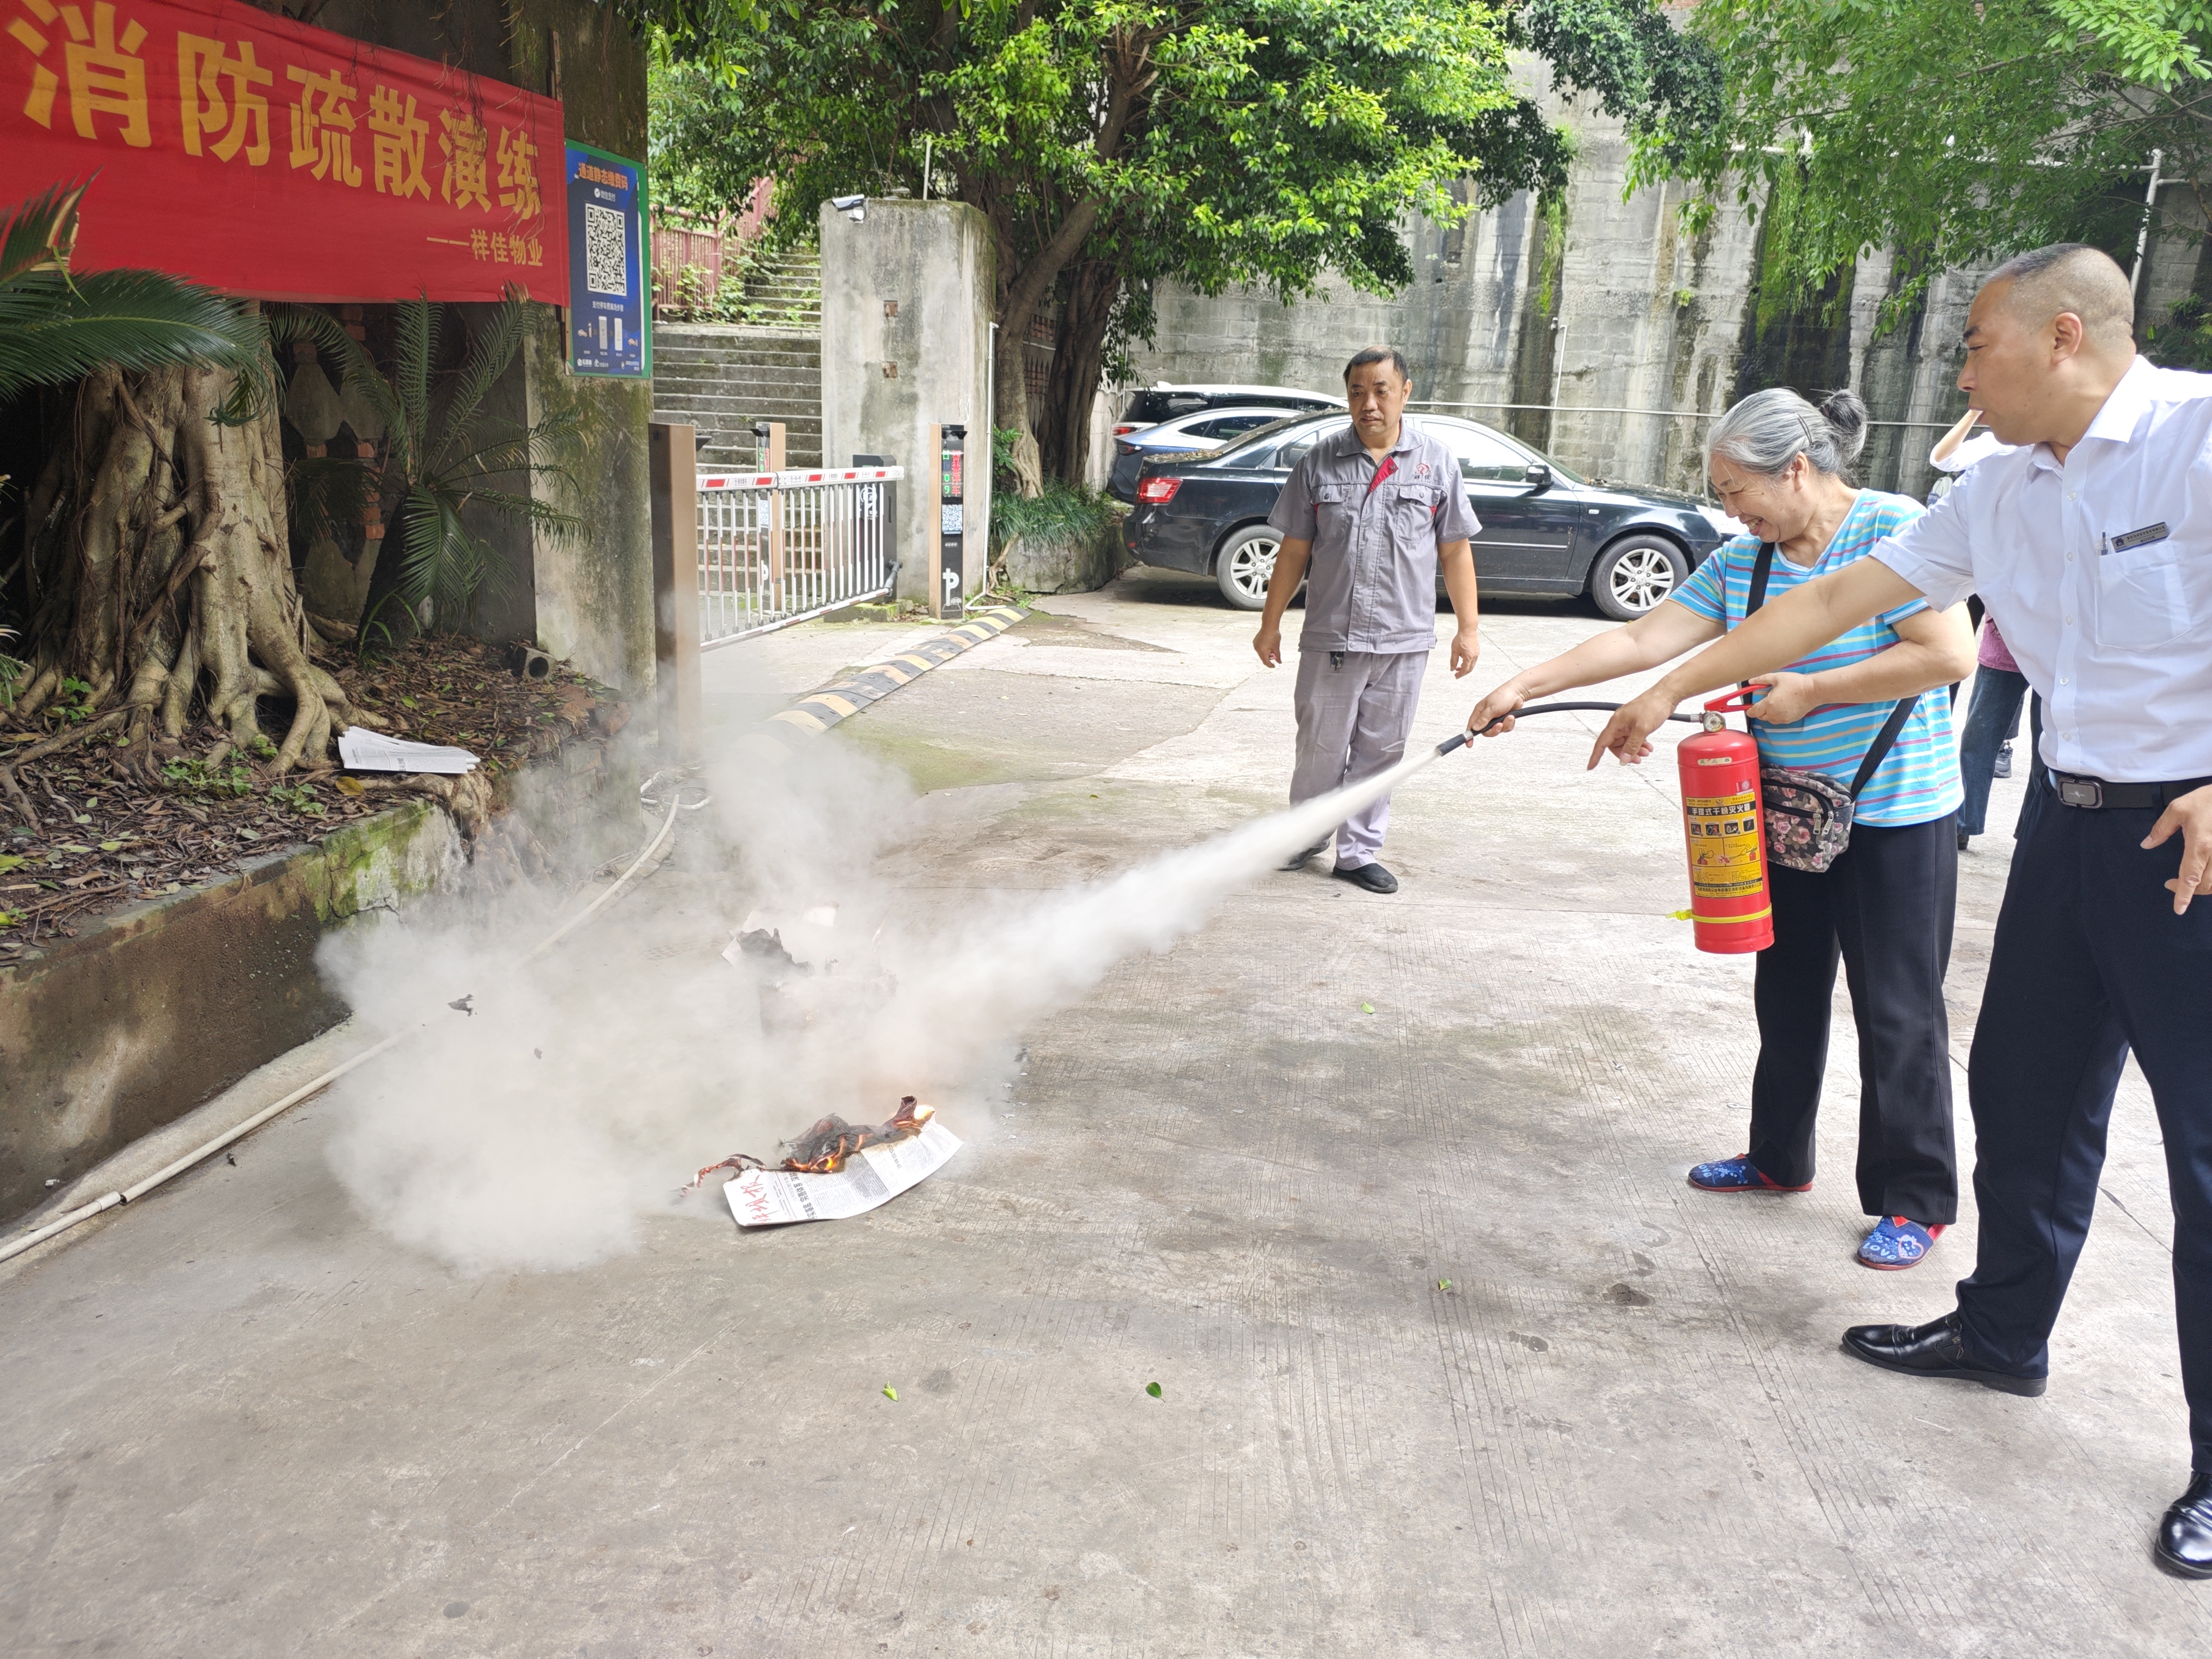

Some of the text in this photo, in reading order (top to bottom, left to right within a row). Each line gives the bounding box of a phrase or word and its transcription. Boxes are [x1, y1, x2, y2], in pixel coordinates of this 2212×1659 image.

[7, 0, 542, 220] 消防疏散演练
[1691, 802, 1751, 816] 手提式干粉灭火器
